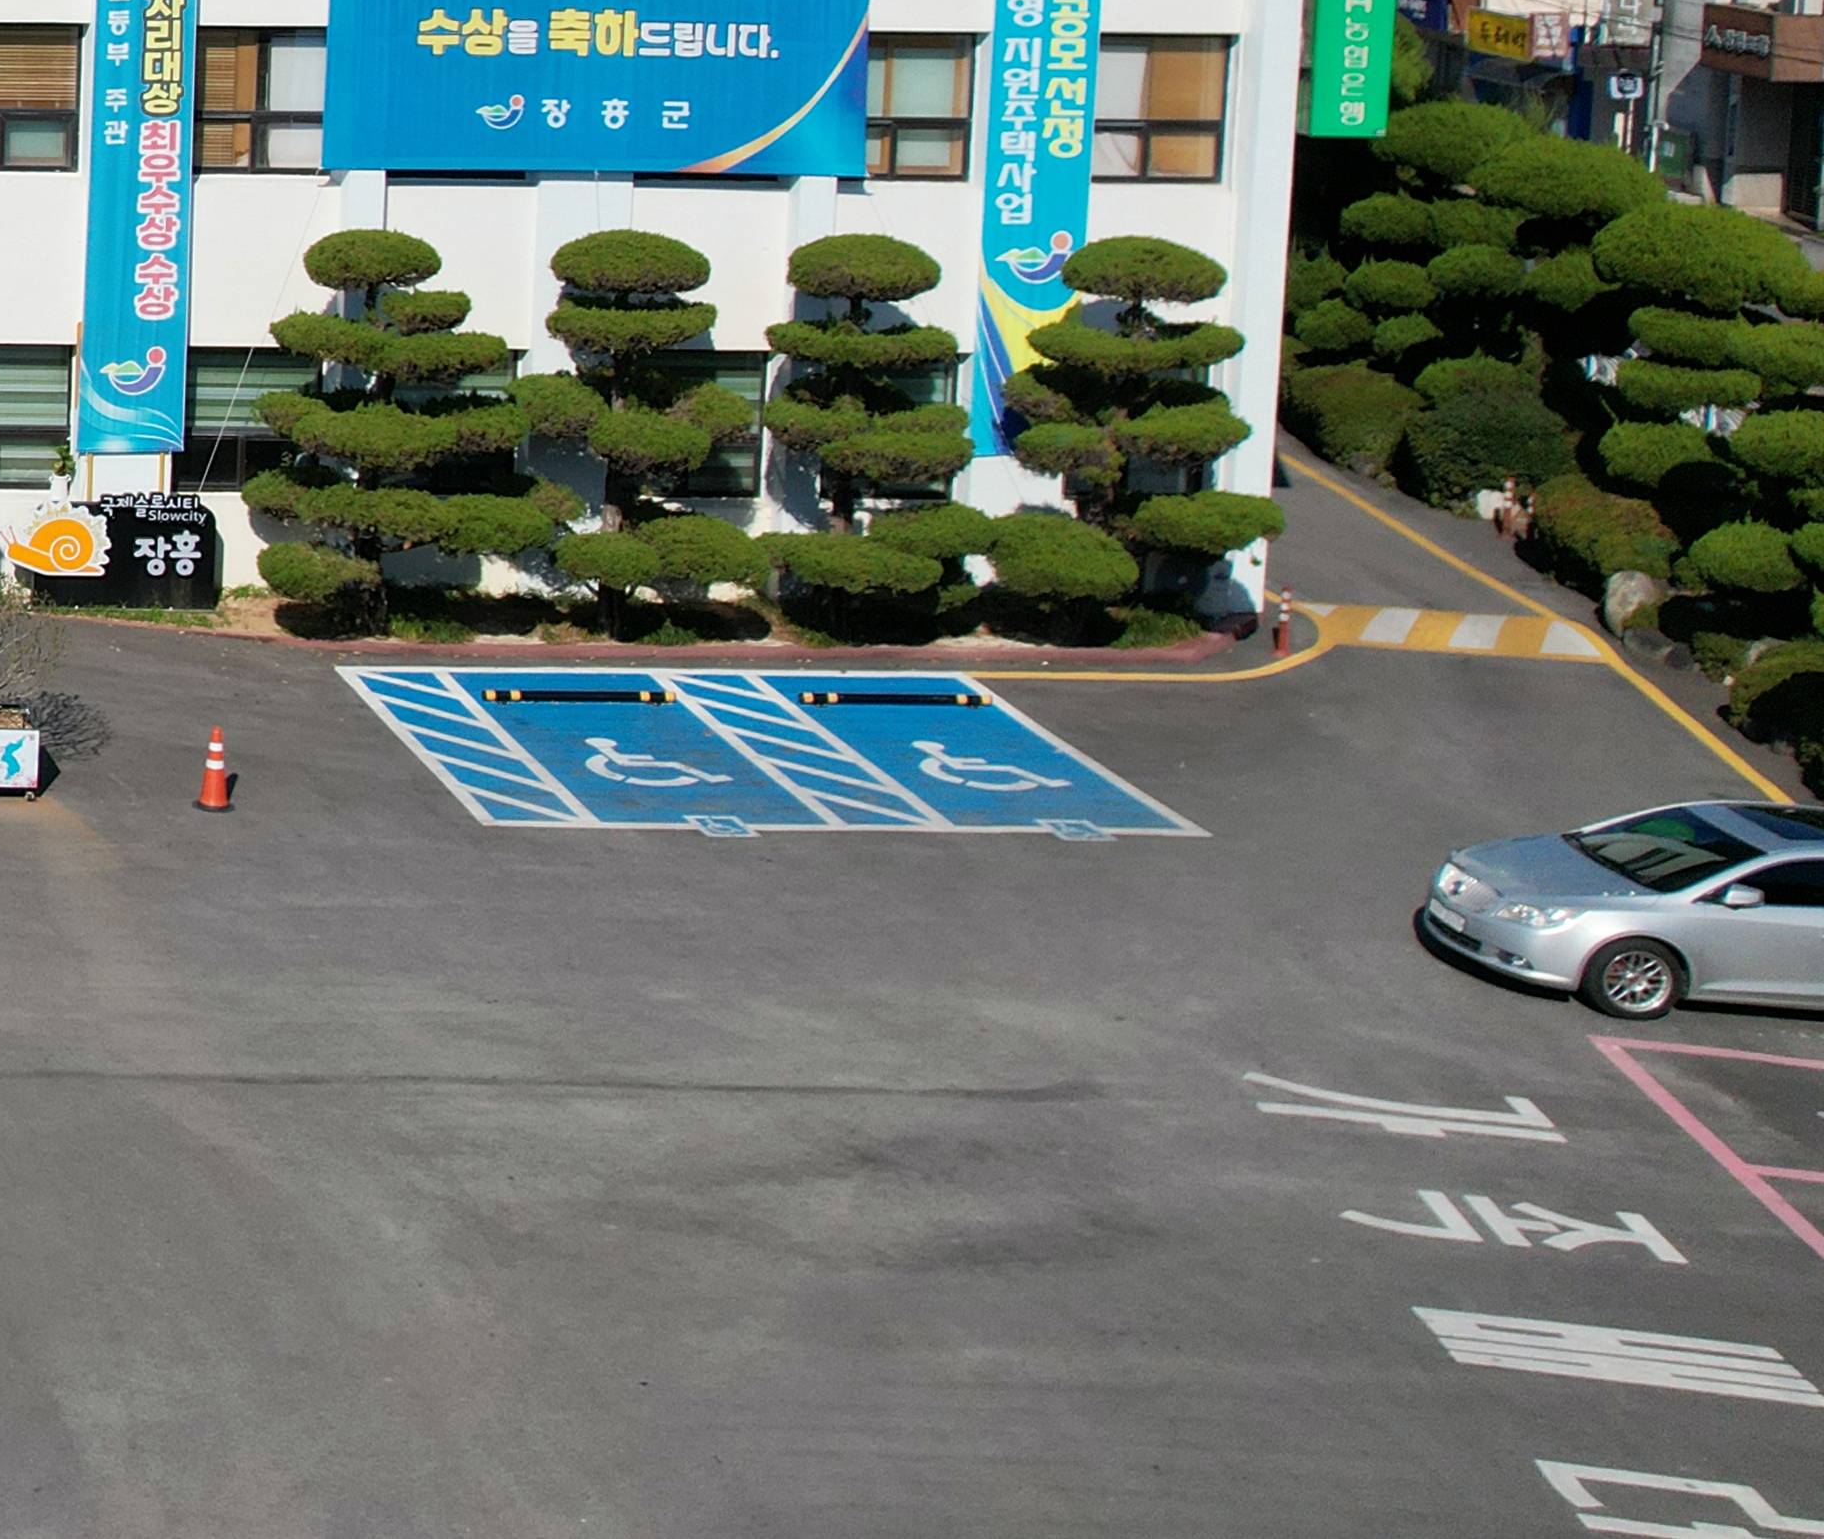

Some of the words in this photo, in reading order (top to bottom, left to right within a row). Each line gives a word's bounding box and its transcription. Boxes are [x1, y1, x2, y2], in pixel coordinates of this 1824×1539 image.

[416, 6, 539, 57] 수상을
[547, 7, 781, 60] 축하드립니다.
[102, 87, 129, 146] 주관
[540, 96, 692, 131] 장흥군
[994, 36, 1043, 226] 지원주택사업
[137, 119, 182, 250] 최우수상
[134, 253, 180, 322] 수상
[100, 494, 199, 519] 국제슬로시티
[148, 509, 208, 525] Slowcity
[133, 529, 202, 577] 장흥
